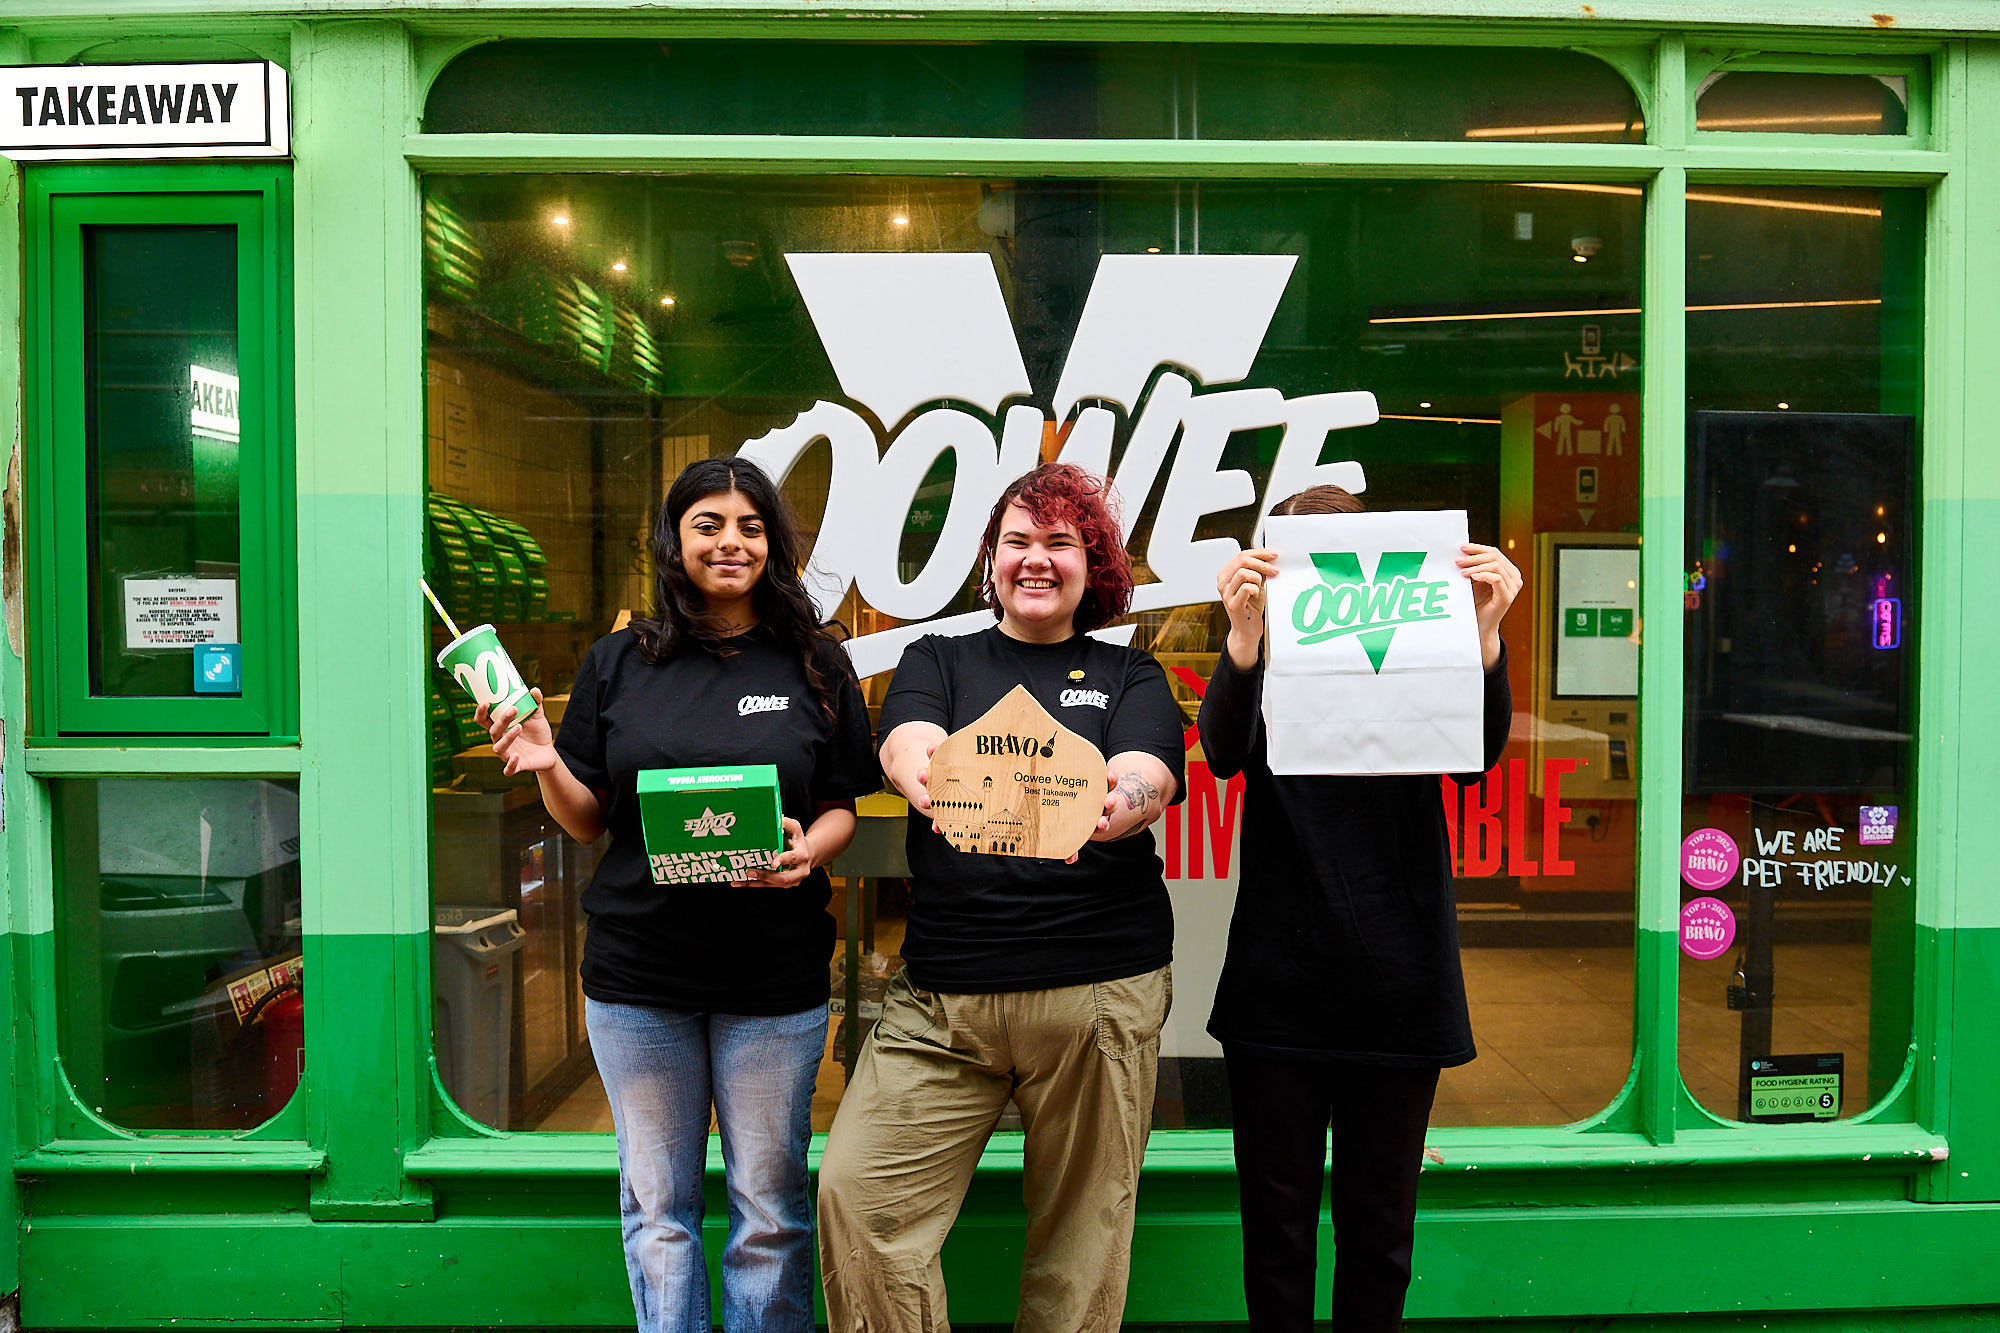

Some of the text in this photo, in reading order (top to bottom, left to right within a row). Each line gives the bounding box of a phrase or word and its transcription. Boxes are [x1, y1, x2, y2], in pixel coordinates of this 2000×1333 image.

[16, 83, 238, 127] TAKEAWAY
[1292, 579, 1450, 638] OOWEE
[737, 694, 790, 716] OOWEE
[1059, 688, 1110, 709] OOWEE
[976, 734, 1039, 757] BRAVO
[697, 774, 743, 784] DELICIOUSLY
[1014, 771, 1088, 788] Oowee Vegan
[1024, 786, 1078, 799] Best Takeaway
[684, 811, 736, 831] OOWEE
[1864, 824, 1894, 834] DOGS
[1688, 834, 1704, 847] TOP
[1755, 827, 1844, 856] WE ARE
[1688, 855, 1728, 873] BRAVO
[1742, 858, 1897, 890] PET FRIENDLY
[1684, 903, 1700, 917] TOP
[1685, 925, 1726, 940] BRAVO
[1810, 1077, 1835, 1085] RATING
[1822, 1095, 1830, 1107] 5
